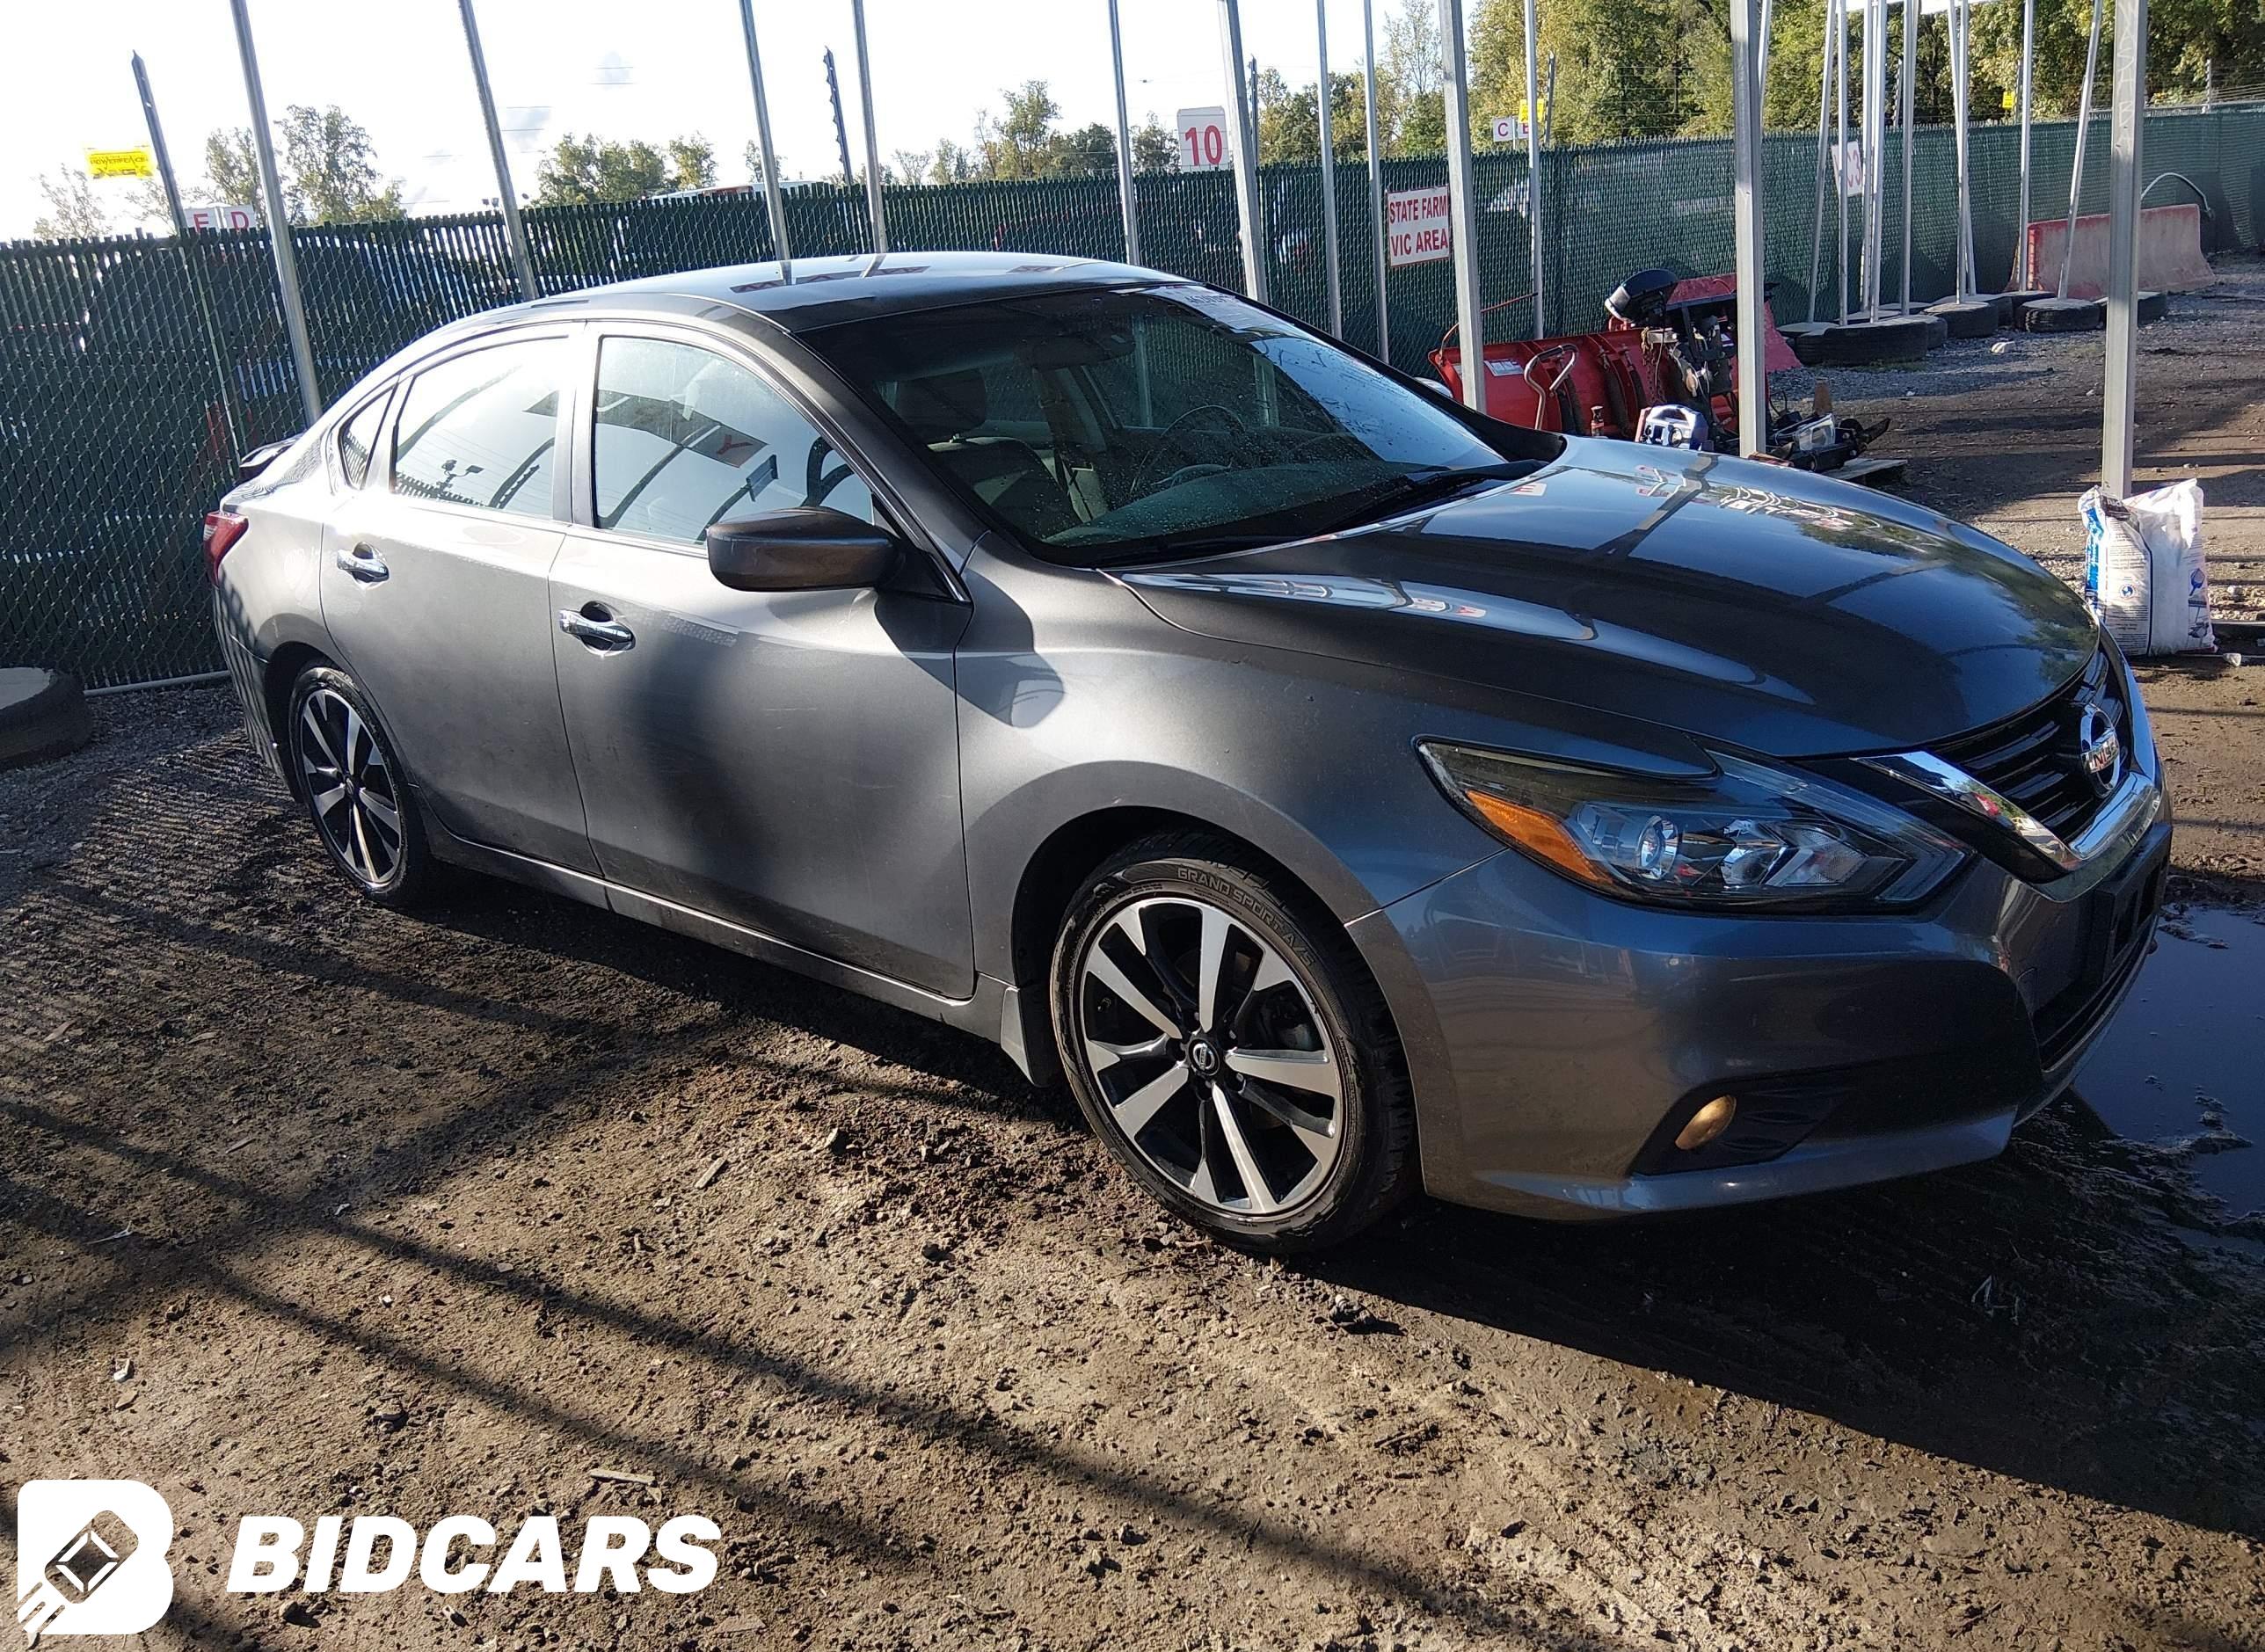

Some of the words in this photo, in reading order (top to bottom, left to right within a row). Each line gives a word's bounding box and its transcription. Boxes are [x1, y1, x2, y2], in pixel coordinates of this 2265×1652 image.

[1497, 122, 1509, 136] C
[1184, 125, 1223, 167] 10
[230, 211, 250, 230] D
[1389, 199, 1419, 224] STATE
[1422, 195, 1447, 219] FARM
[1391, 233, 1412, 257] VIC
[1416, 229, 1449, 254] AREA
[1177, 867, 1230, 896] GRAND
[1232, 890, 1285, 931] SPORT
